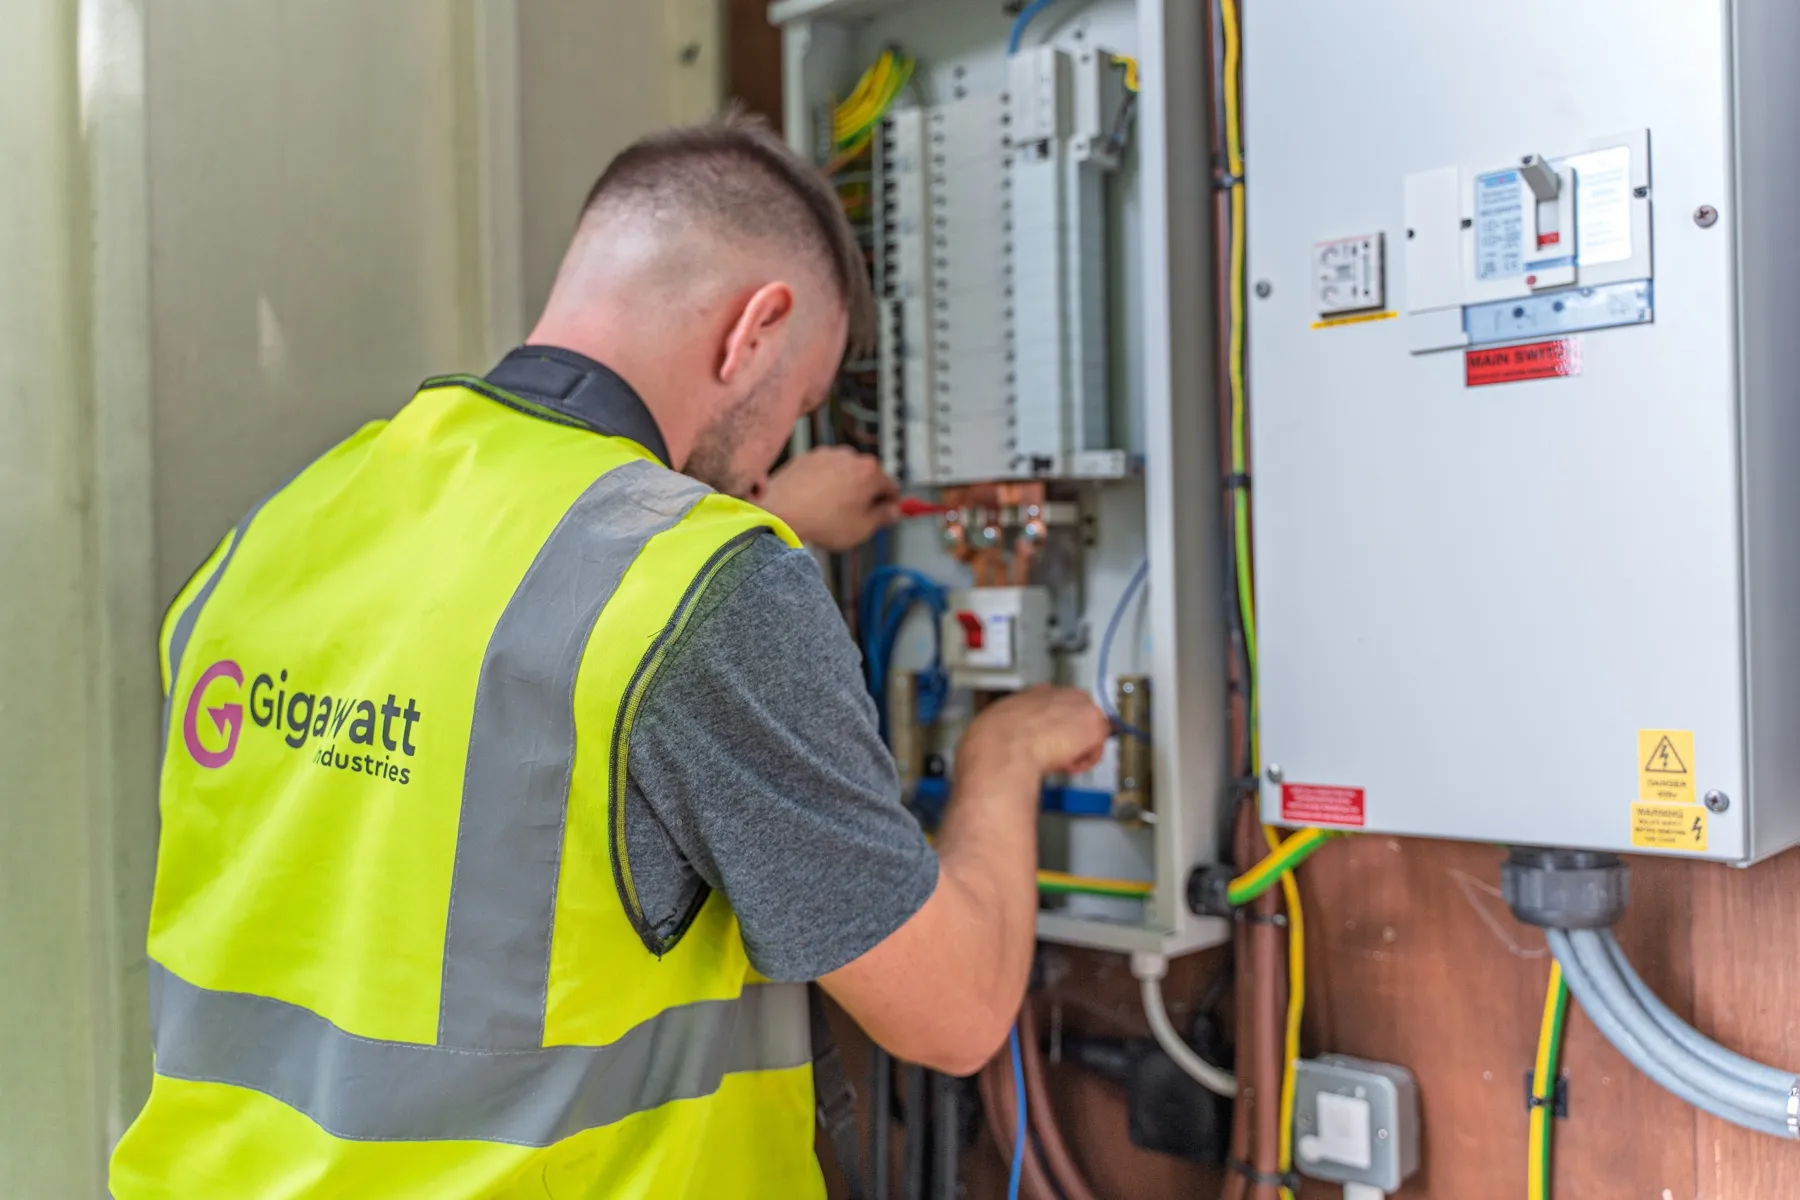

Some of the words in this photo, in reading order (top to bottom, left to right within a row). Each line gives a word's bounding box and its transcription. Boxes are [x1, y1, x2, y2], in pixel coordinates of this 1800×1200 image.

[1469, 353, 1509, 368] MAIN
[250, 668, 421, 757] Gigawatt
[312, 744, 411, 785] ndustries
